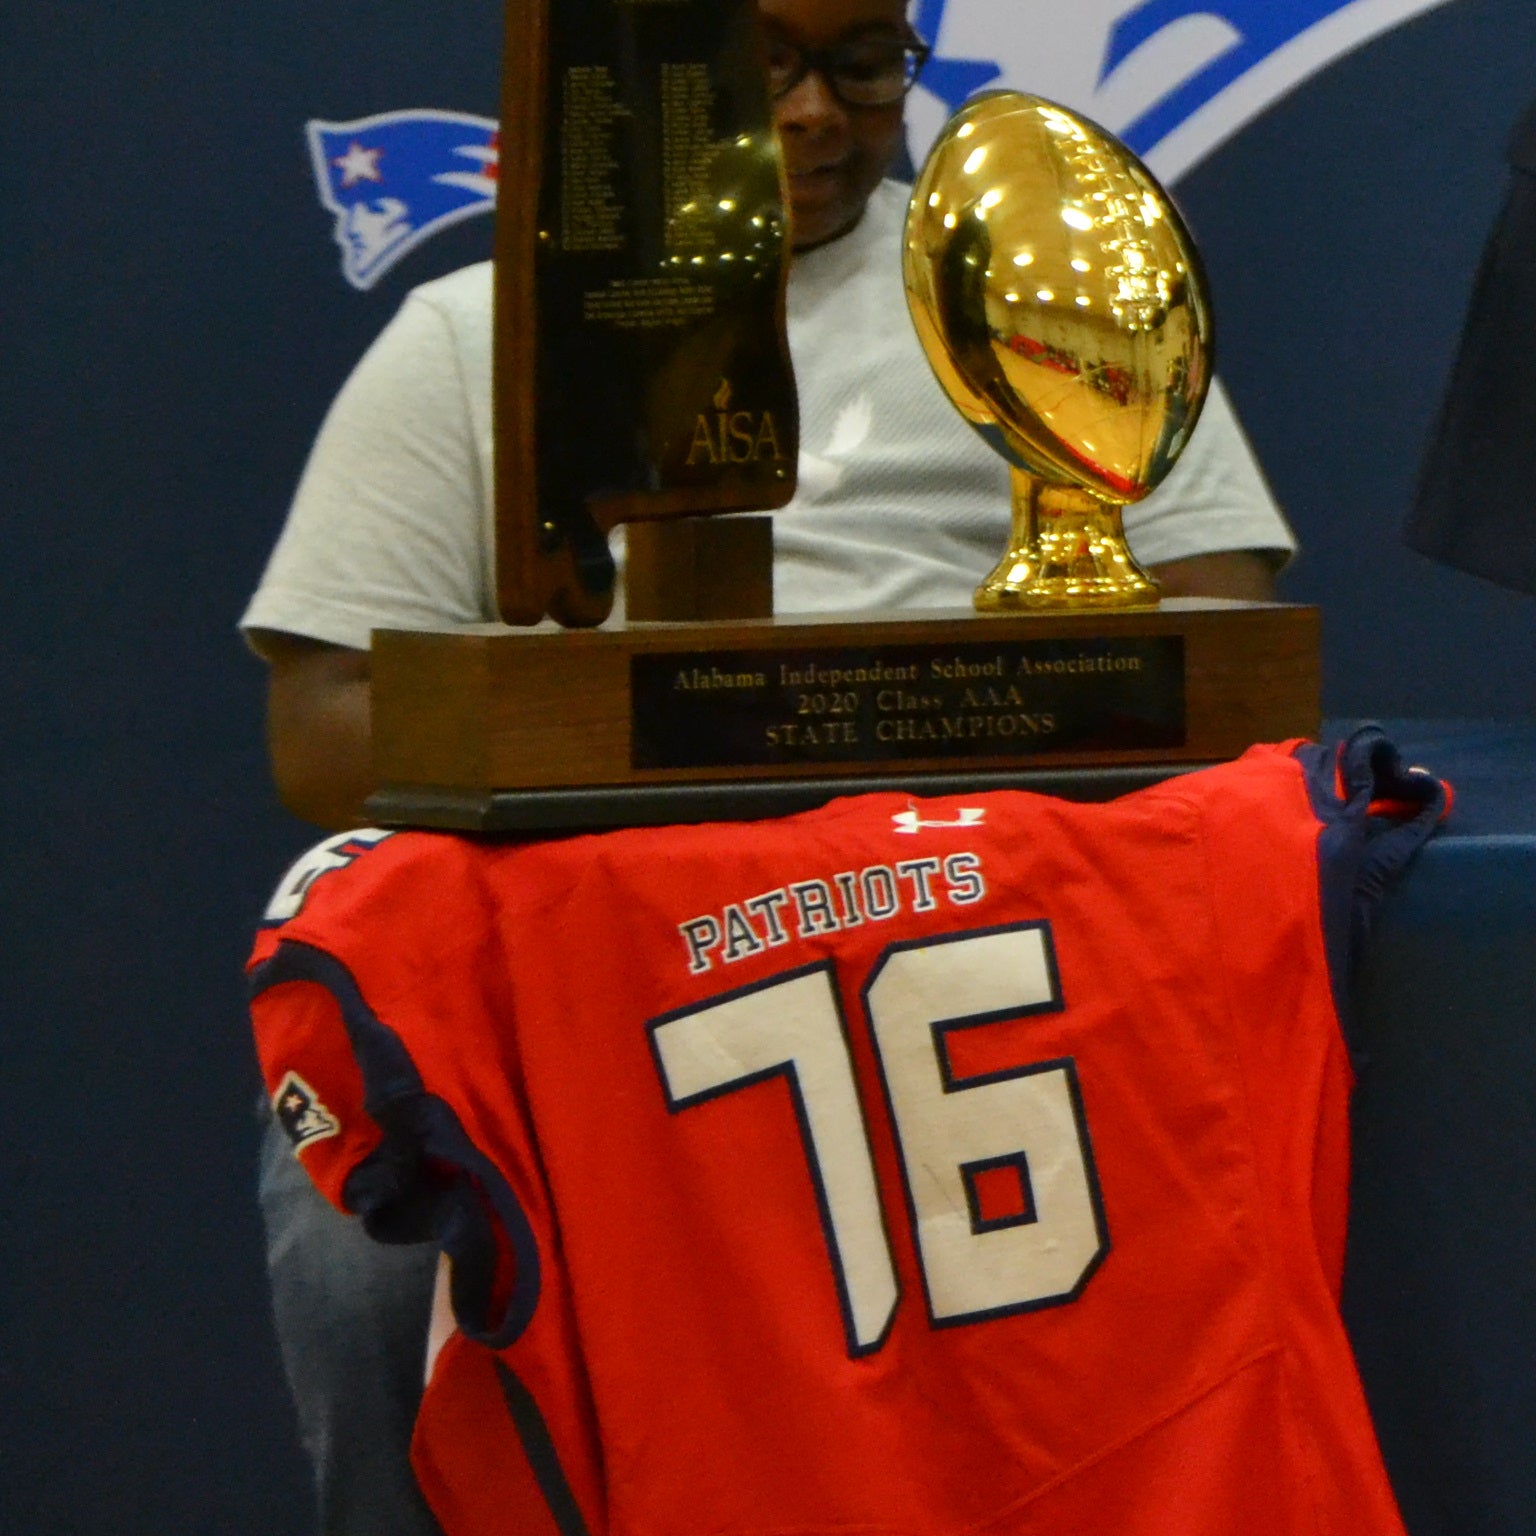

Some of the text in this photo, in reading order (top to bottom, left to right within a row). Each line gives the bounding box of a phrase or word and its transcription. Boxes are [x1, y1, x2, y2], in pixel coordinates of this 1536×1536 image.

[684, 410, 783, 465] AISA
[674, 651, 1142, 691] Alabama Independent School Association
[797, 683, 1026, 716] 2020 Class AAA
[765, 711, 1057, 747] STATE CHAMPIONS
[678, 852, 986, 975] PATRIOTS
[644, 919, 1112, 1361] 76
